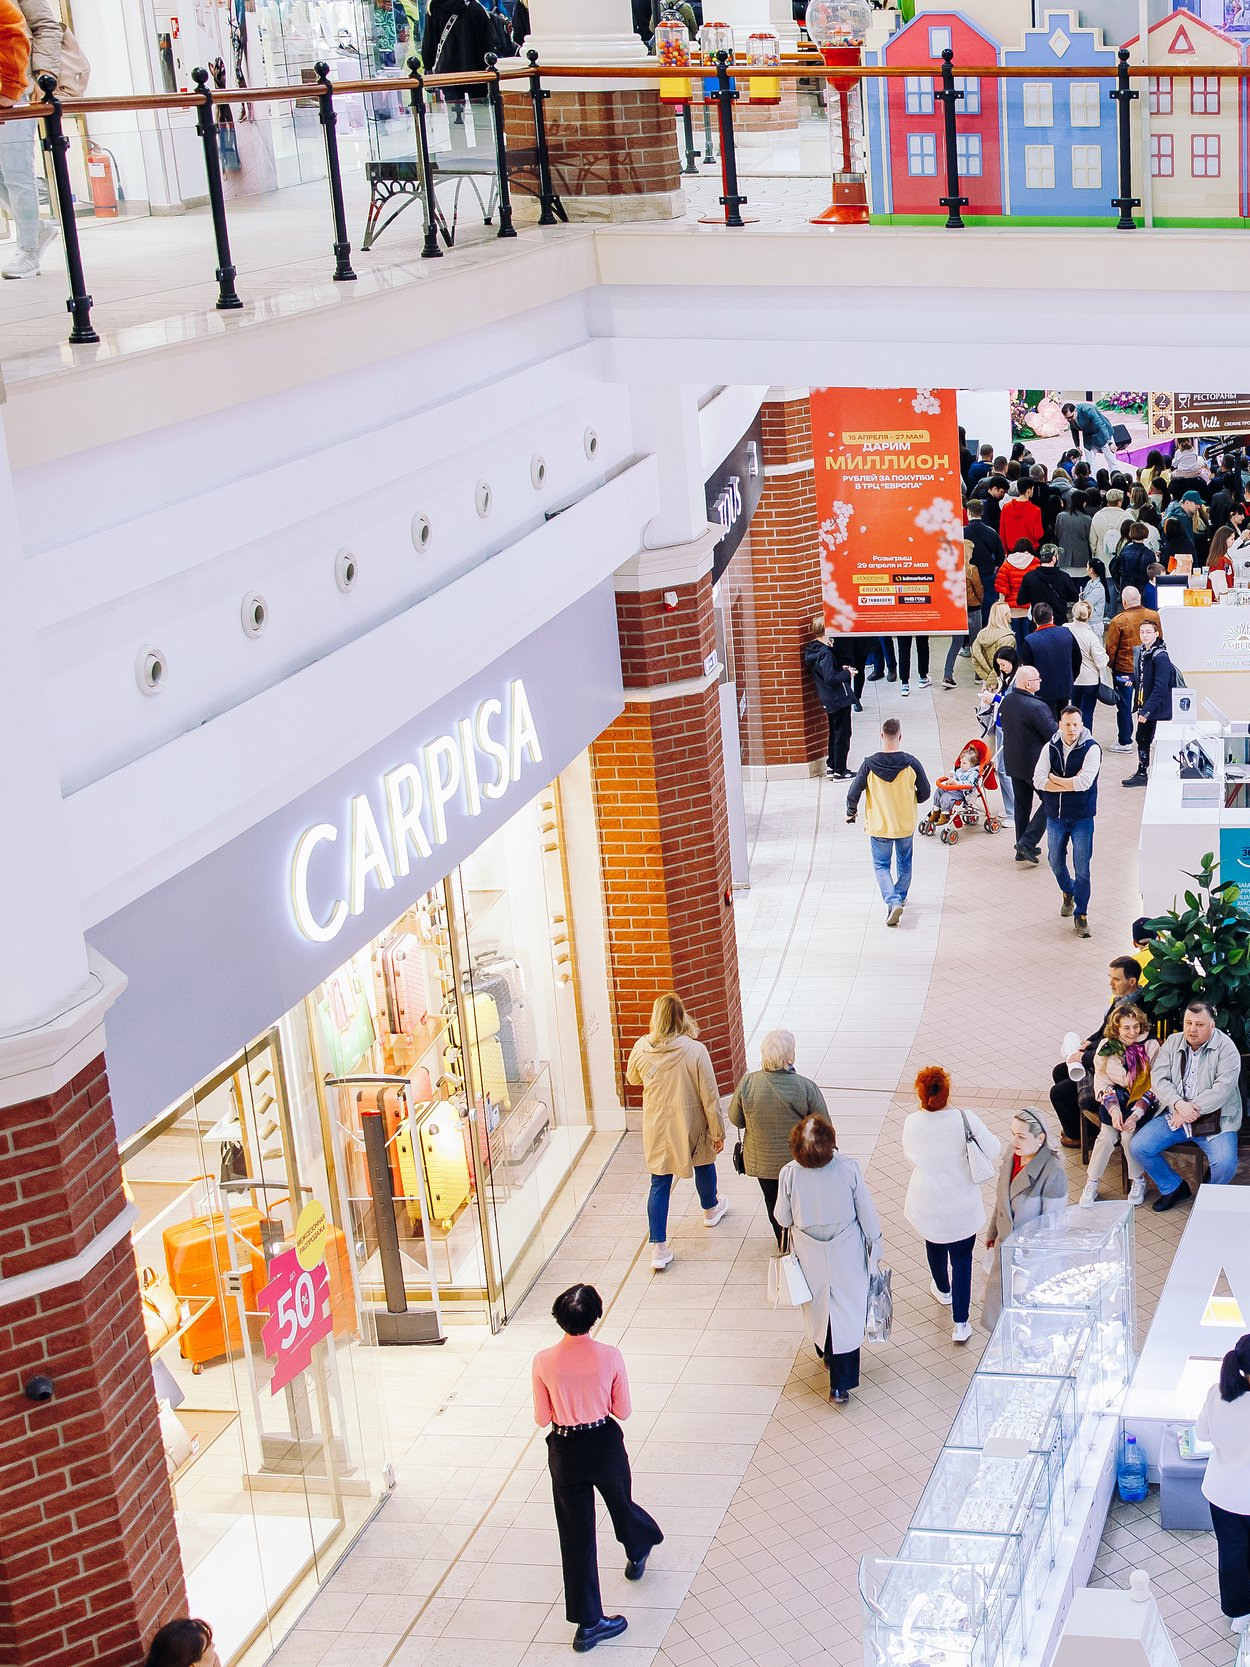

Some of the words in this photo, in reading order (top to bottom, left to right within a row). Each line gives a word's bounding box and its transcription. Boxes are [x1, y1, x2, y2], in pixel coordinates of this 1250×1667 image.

[1159, 394, 1166, 405] 2
[1193, 392, 1237, 401] РЕСТОРАНЫ
[1159, 416, 1166, 428] 1
[1180, 415, 1200, 430] Bon
[1201, 415, 1221, 429] Ville
[863, 442, 911, 452] ДАРИМ
[825, 454, 949, 471] МИЛЛИОН
[842, 473, 879, 482] РУБЛЕЙ
[872, 555, 912, 563] Розыгрыш
[290, 679, 543, 942] CARPISA
[277, 1271, 315, 1350] 50
